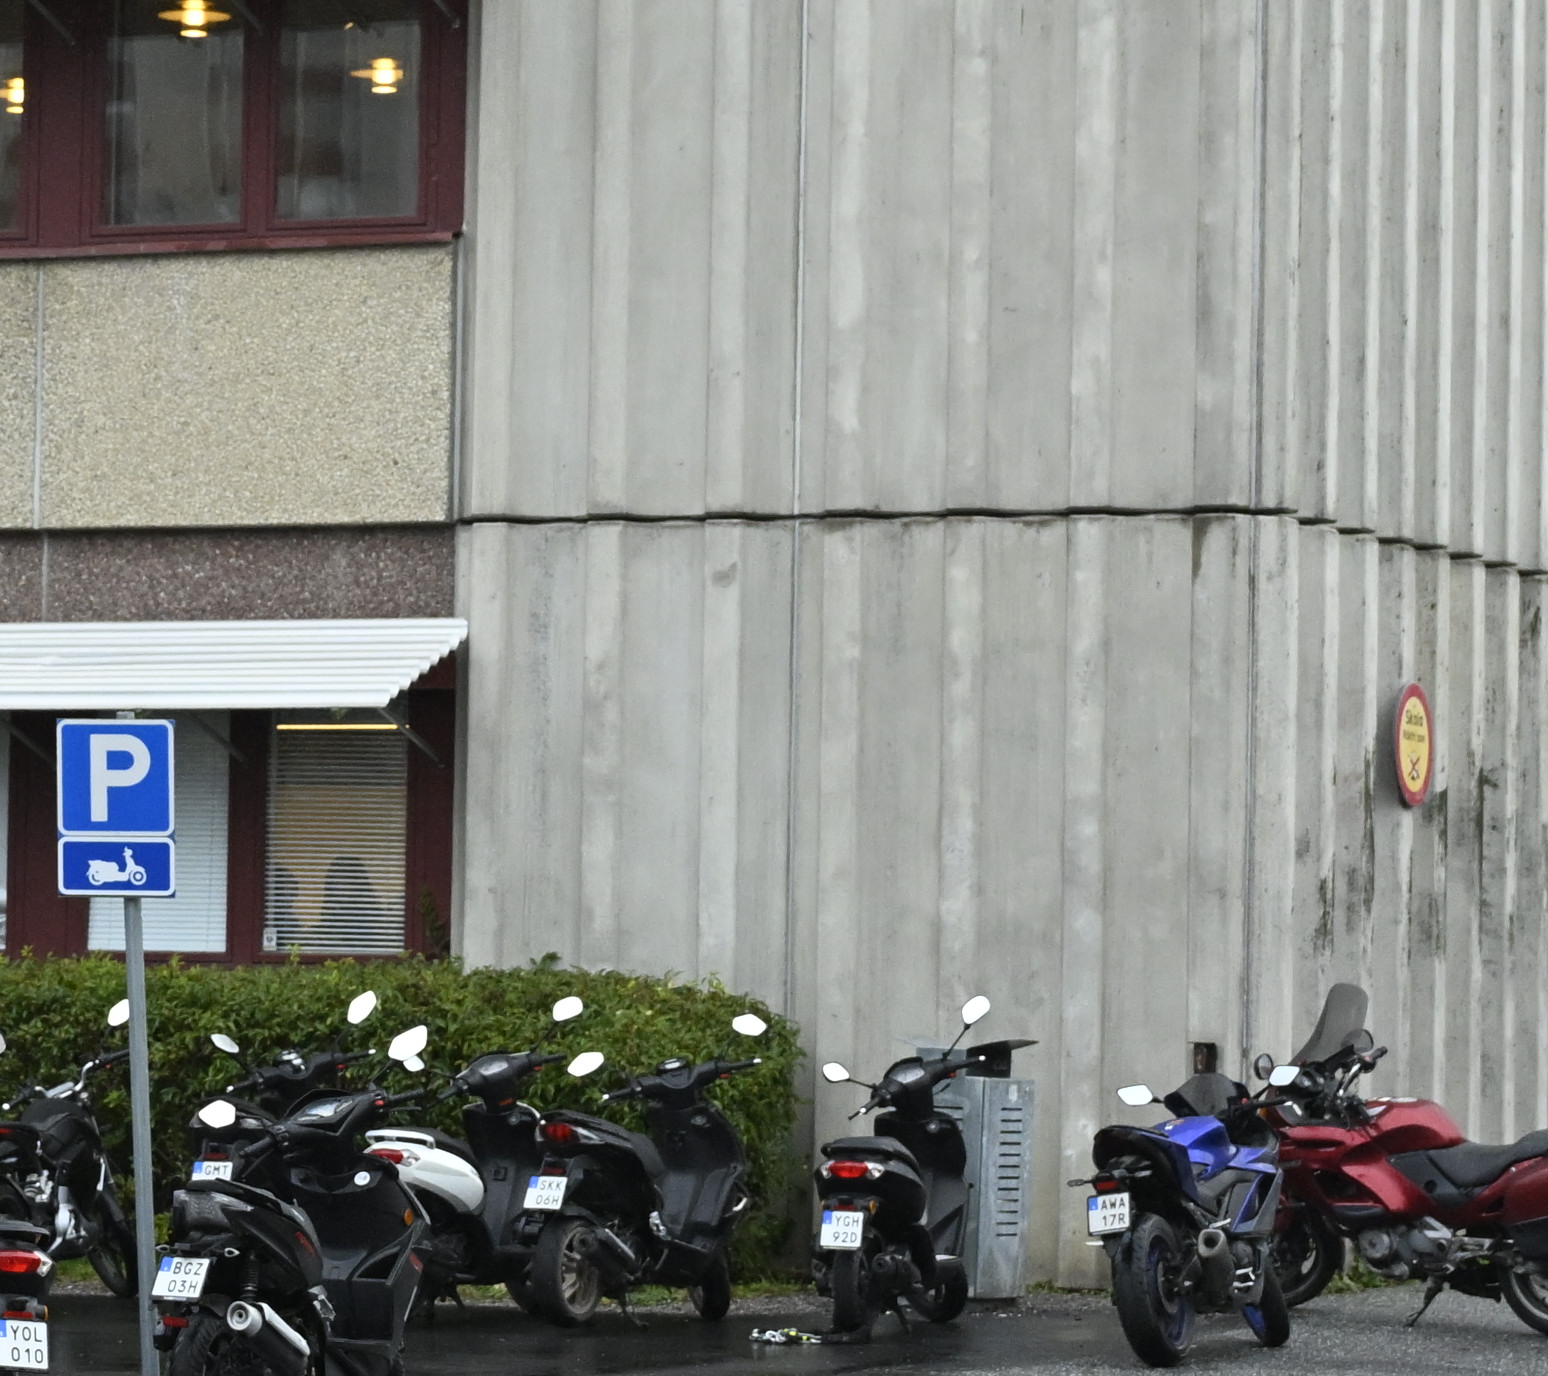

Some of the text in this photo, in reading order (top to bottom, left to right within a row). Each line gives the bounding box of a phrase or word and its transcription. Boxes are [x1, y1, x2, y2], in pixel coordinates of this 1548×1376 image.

[90, 734, 152, 822] P
[205, 1165, 229, 1176] GMT
[540, 1180, 564, 1191] SKK
[1101, 1197, 1126, 1211] AWA
[835, 1215, 860, 1228] YGH
[1102, 1213, 1126, 1227] 17R
[832, 1231, 858, 1243] 92D
[172, 1261, 203, 1275] BGZ
[167, 1279, 199, 1293] 03H
[10, 1326, 43, 1342] YOL
[11, 1347, 44, 1364] 010
